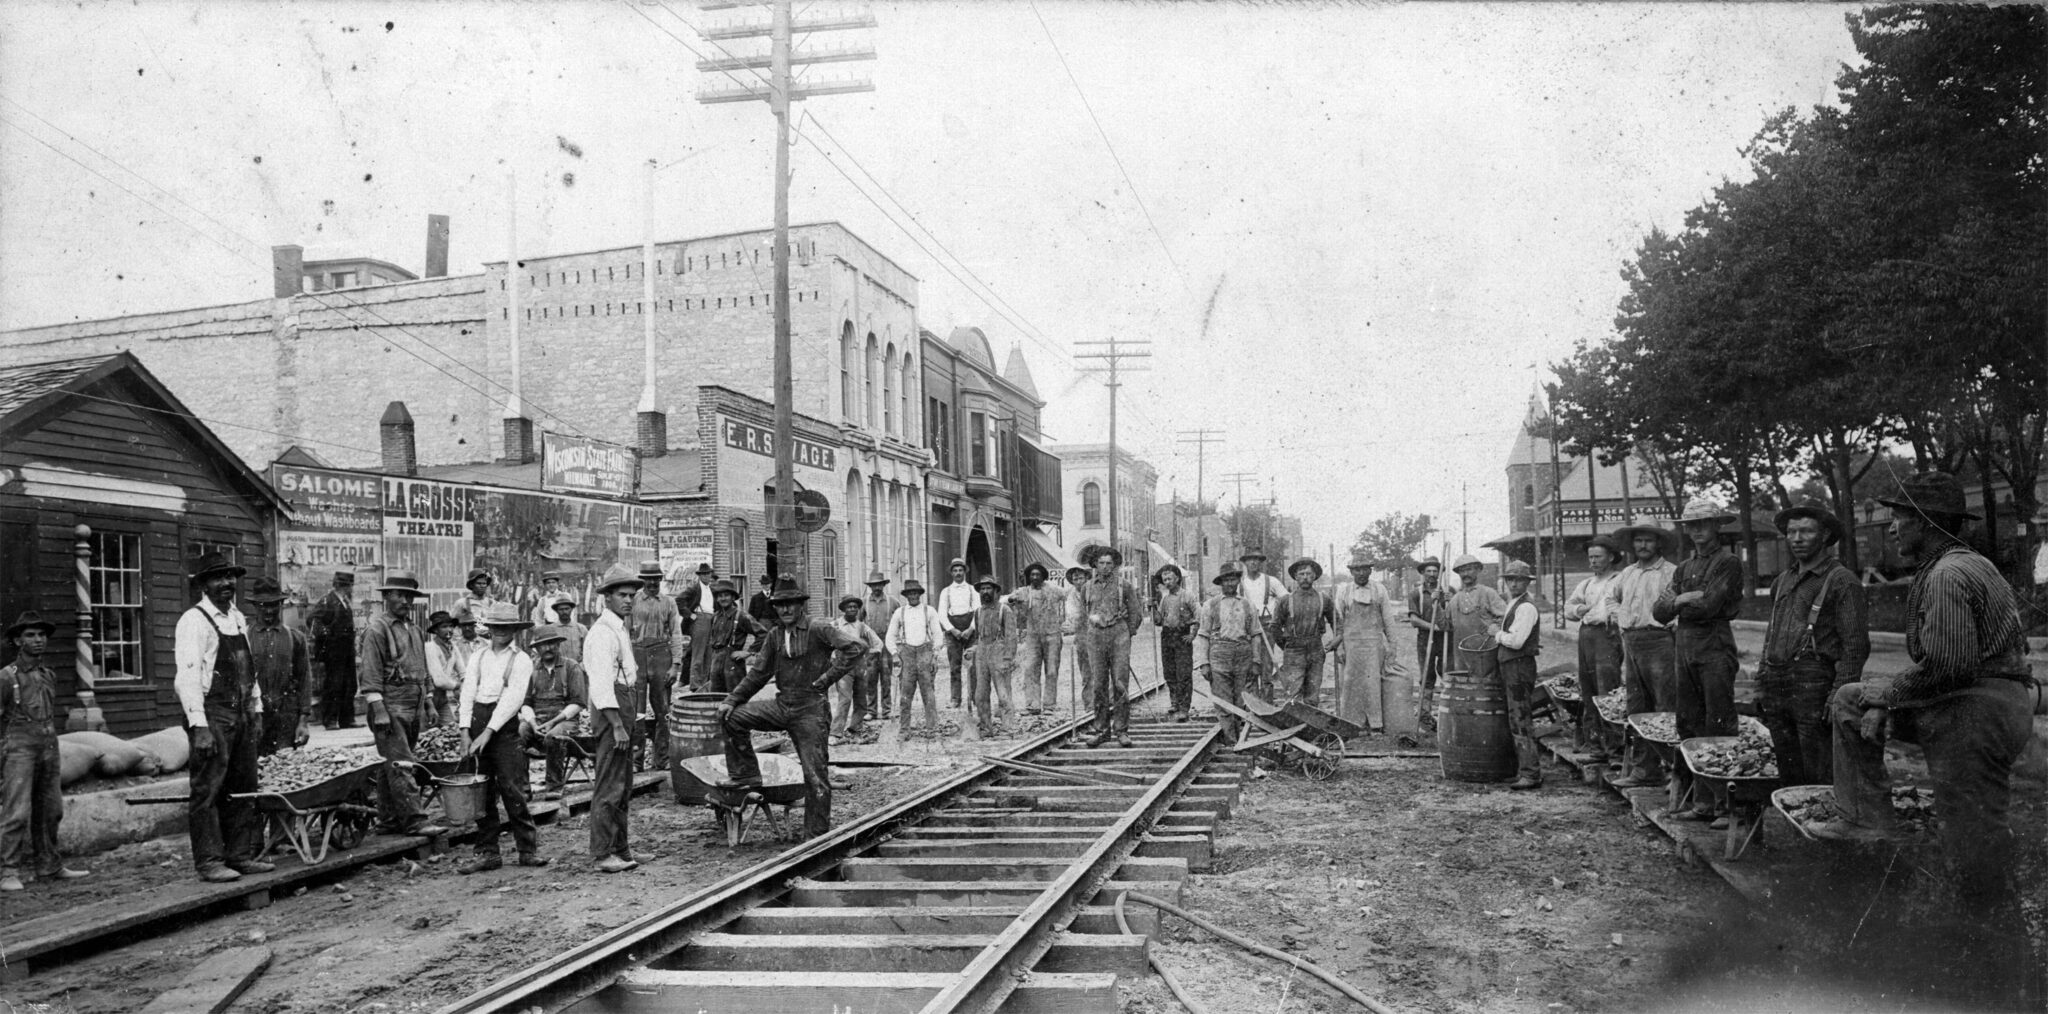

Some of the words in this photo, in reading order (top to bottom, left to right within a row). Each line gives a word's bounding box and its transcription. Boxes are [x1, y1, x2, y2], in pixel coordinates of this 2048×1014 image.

[546, 441, 585, 479] WISCONSIN
[586, 444, 606, 471] STATE
[281, 472, 377, 499] SALOME
[383, 480, 407, 518] LA
[409, 483, 475, 521] CROSSE
[323, 512, 381, 530] Washboards
[397, 521, 463, 536] THEATRE
[1555, 516, 1593, 524] CHICAG
